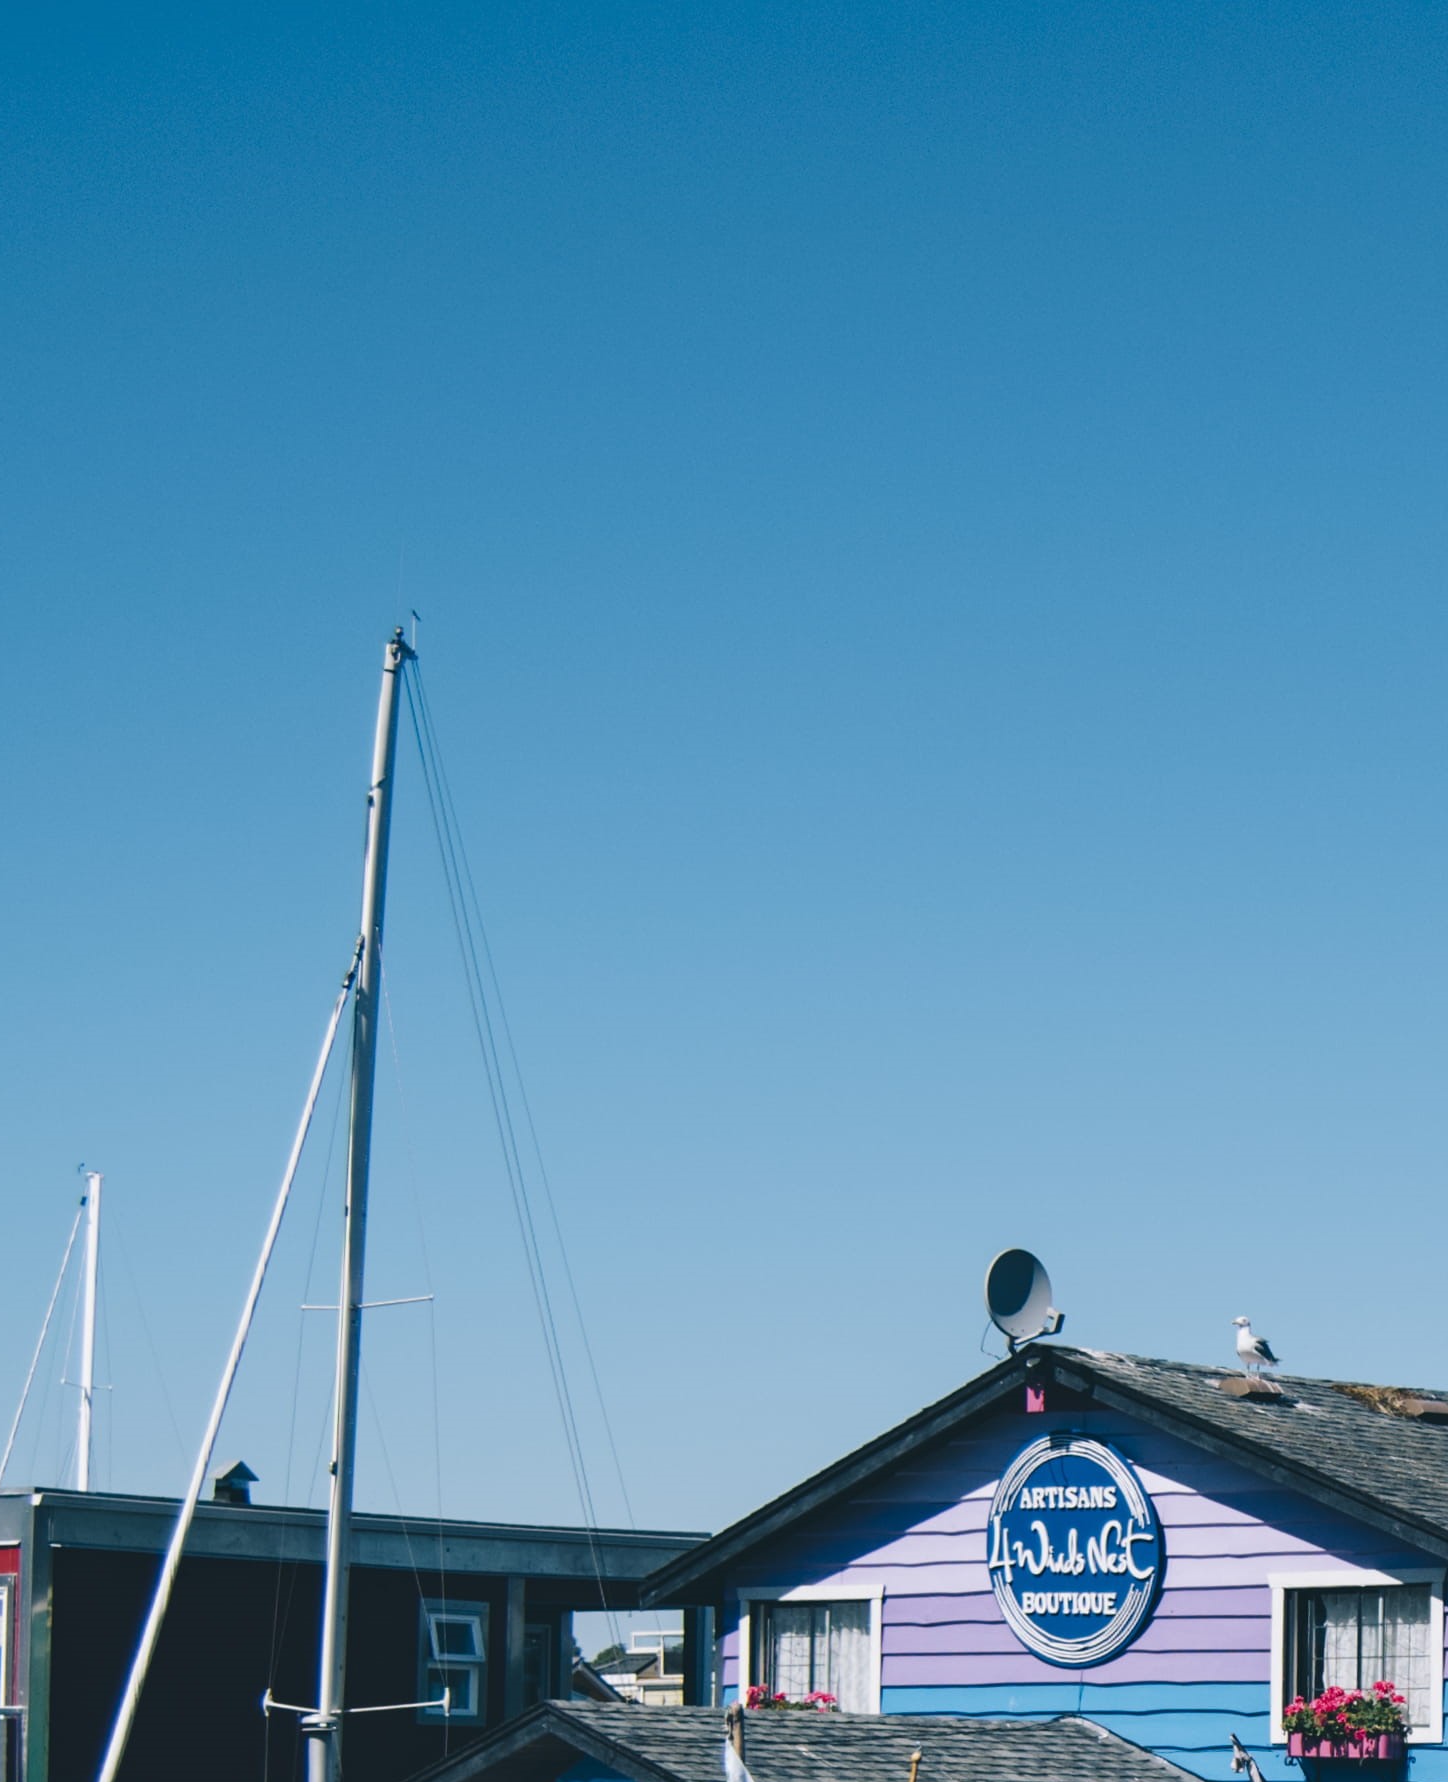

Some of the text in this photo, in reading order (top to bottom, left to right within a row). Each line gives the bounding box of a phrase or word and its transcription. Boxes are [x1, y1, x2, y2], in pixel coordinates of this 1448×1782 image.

[1020, 1486, 1117, 1510] ARTISANS
[989, 1515, 1155, 1584] 4 Winds Nest
[1022, 1592, 1117, 1615] BOUTIQUE
